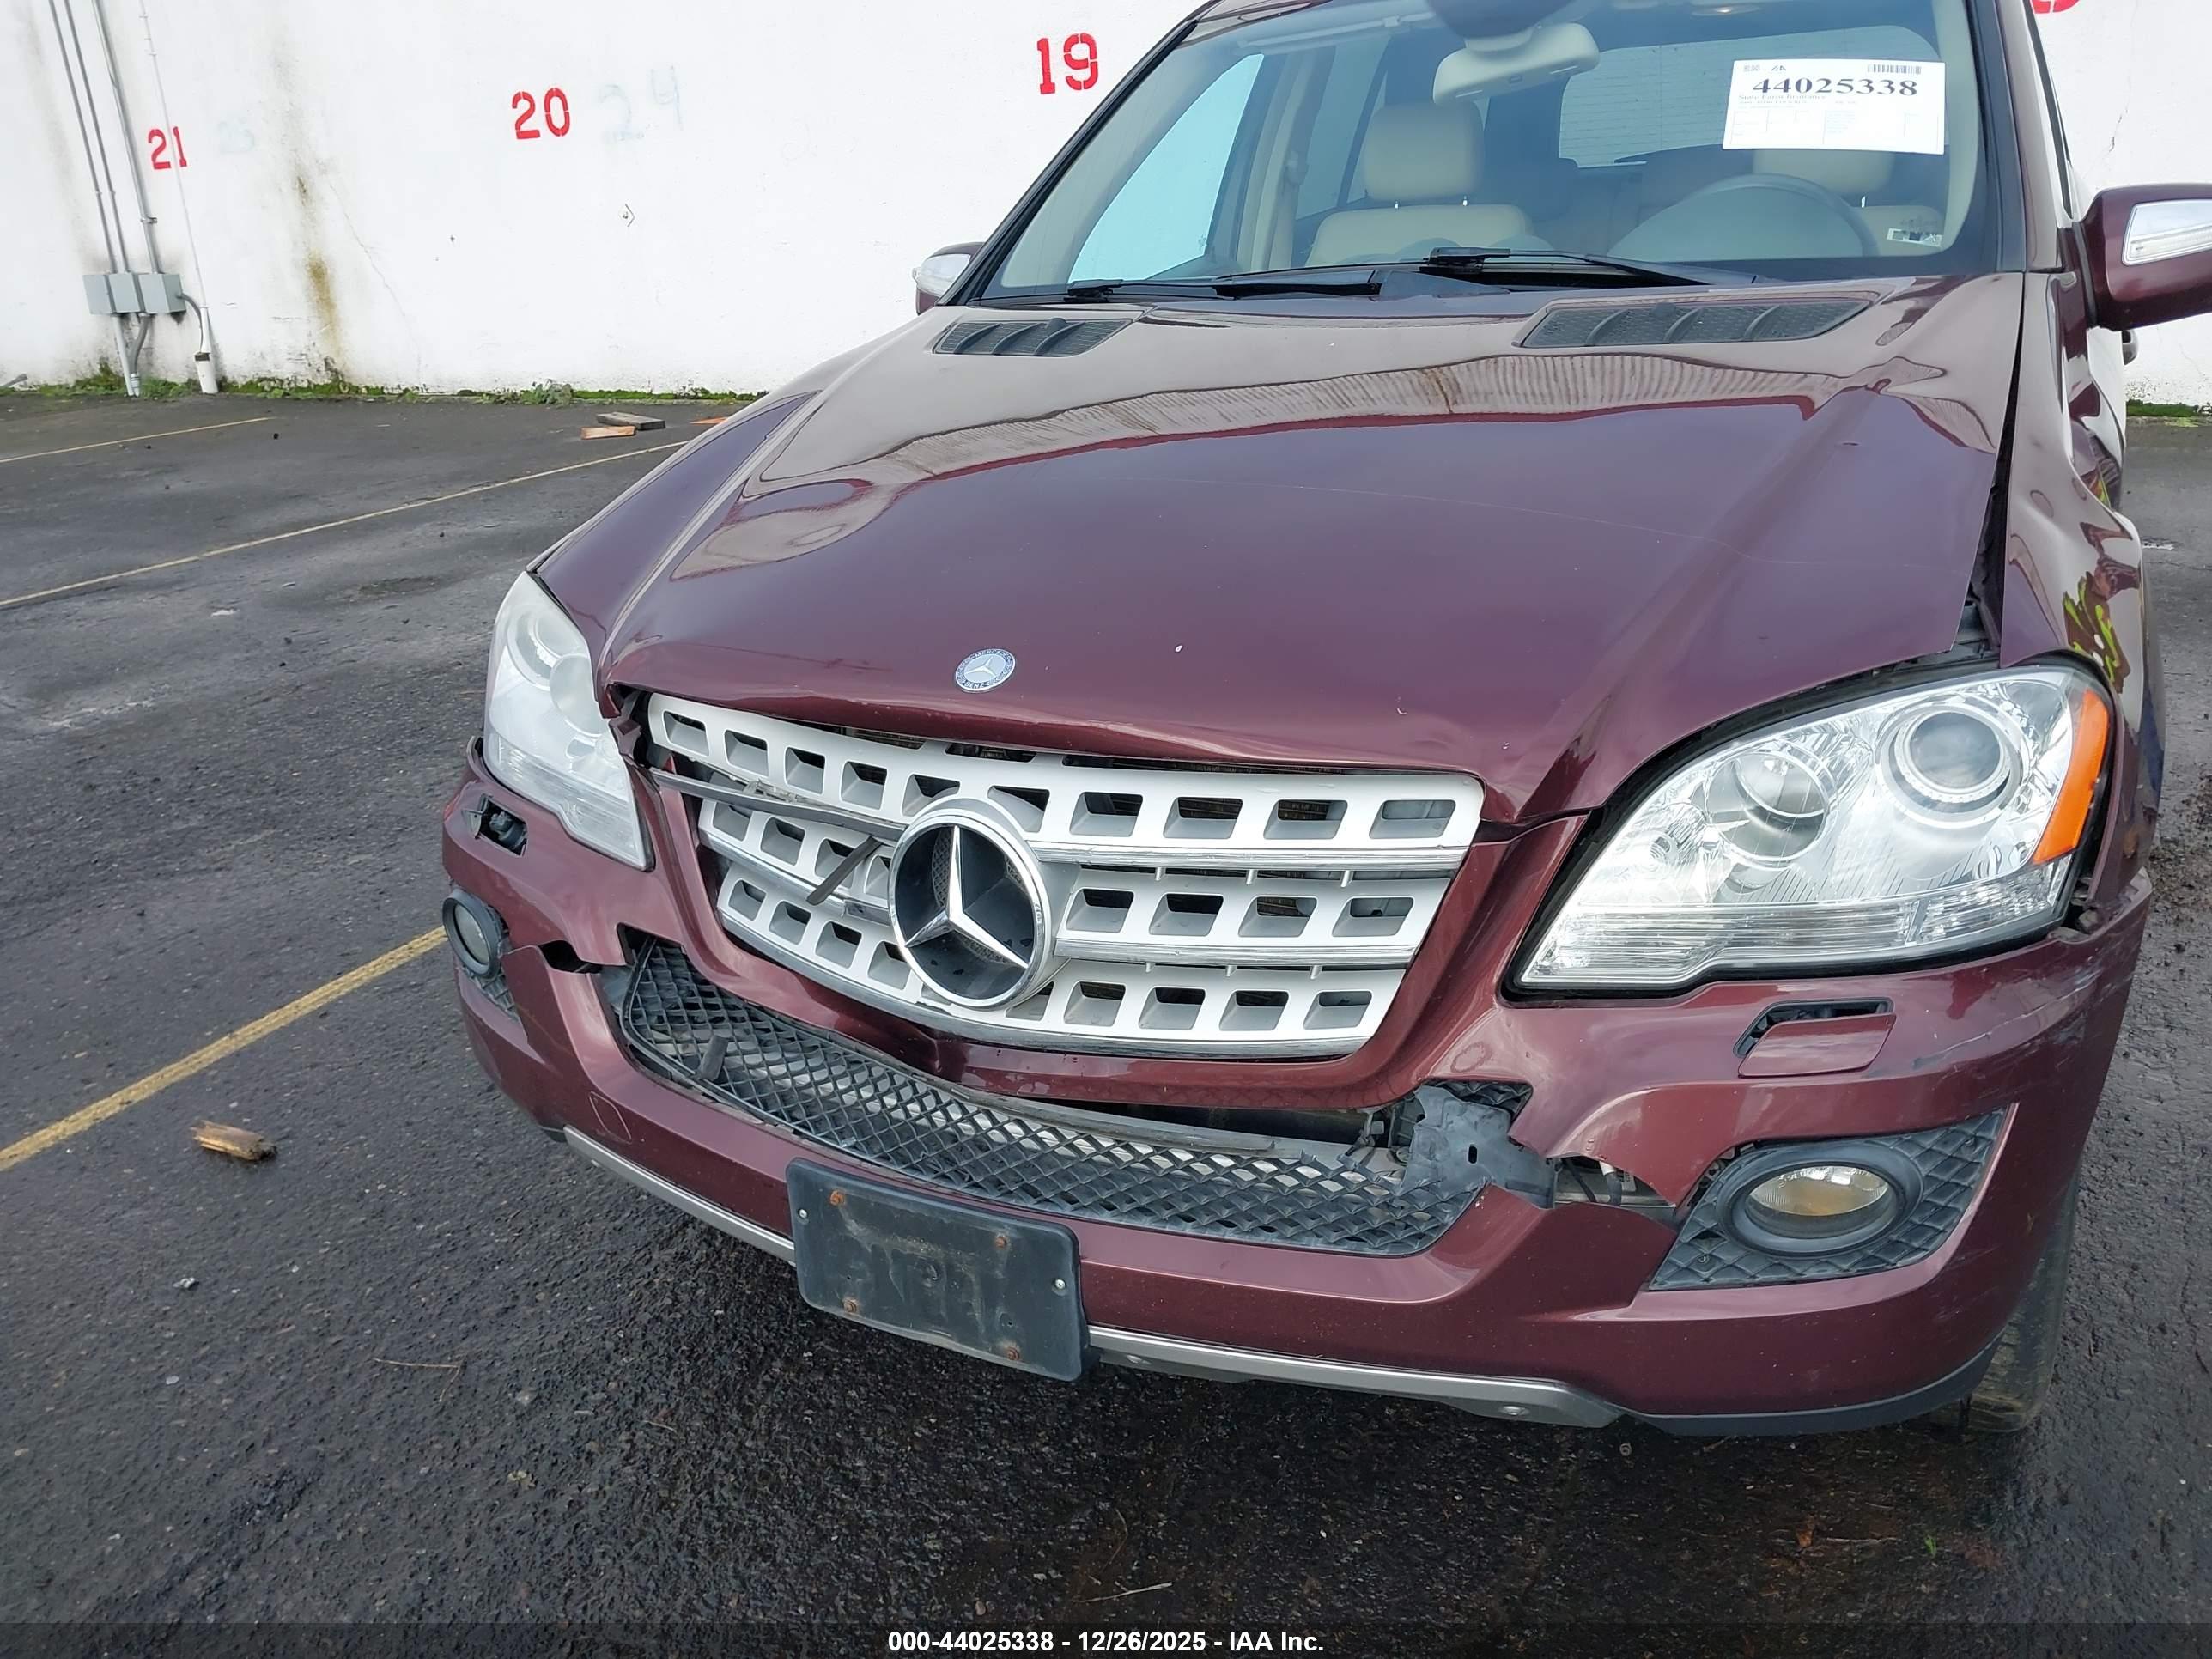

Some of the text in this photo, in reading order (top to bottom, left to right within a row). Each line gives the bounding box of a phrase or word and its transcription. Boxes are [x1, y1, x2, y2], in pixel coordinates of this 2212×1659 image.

[1036, 32, 1098, 94] 19
[1753, 77, 1917, 96] 44025338
[511, 87, 570, 140] 20
[148, 126, 187, 170] 21
